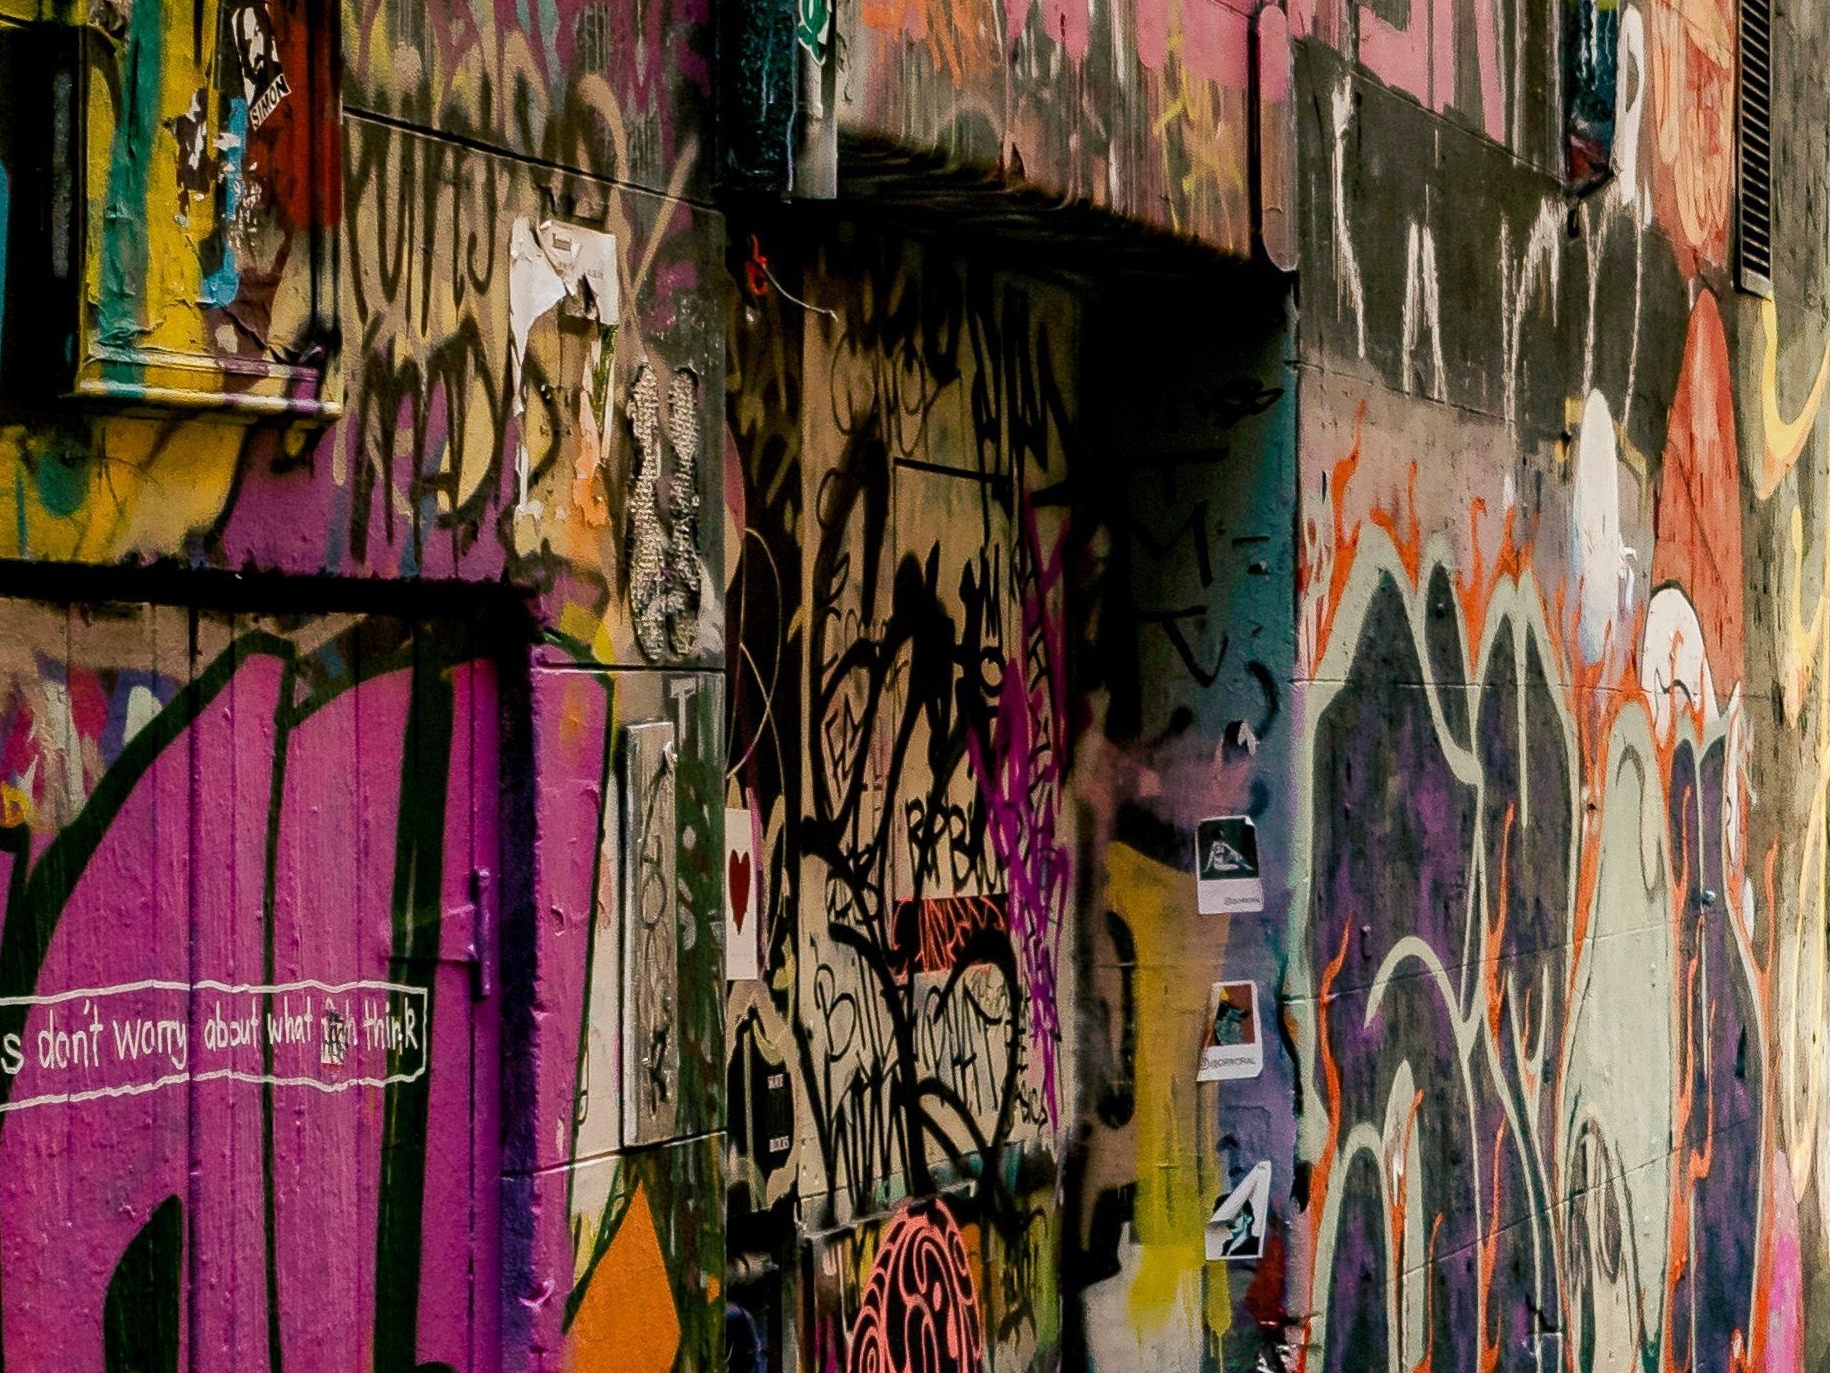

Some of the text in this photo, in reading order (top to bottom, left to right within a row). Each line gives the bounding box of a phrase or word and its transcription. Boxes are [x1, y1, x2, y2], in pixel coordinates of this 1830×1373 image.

[251, 74, 290, 129] SIMON
[38, 999, 104, 1070] don't
[113, 1018, 189, 1071] worry
[204, 998, 260, 1052] about
[268, 996, 313, 1046] what
[362, 998, 419, 1056] think
